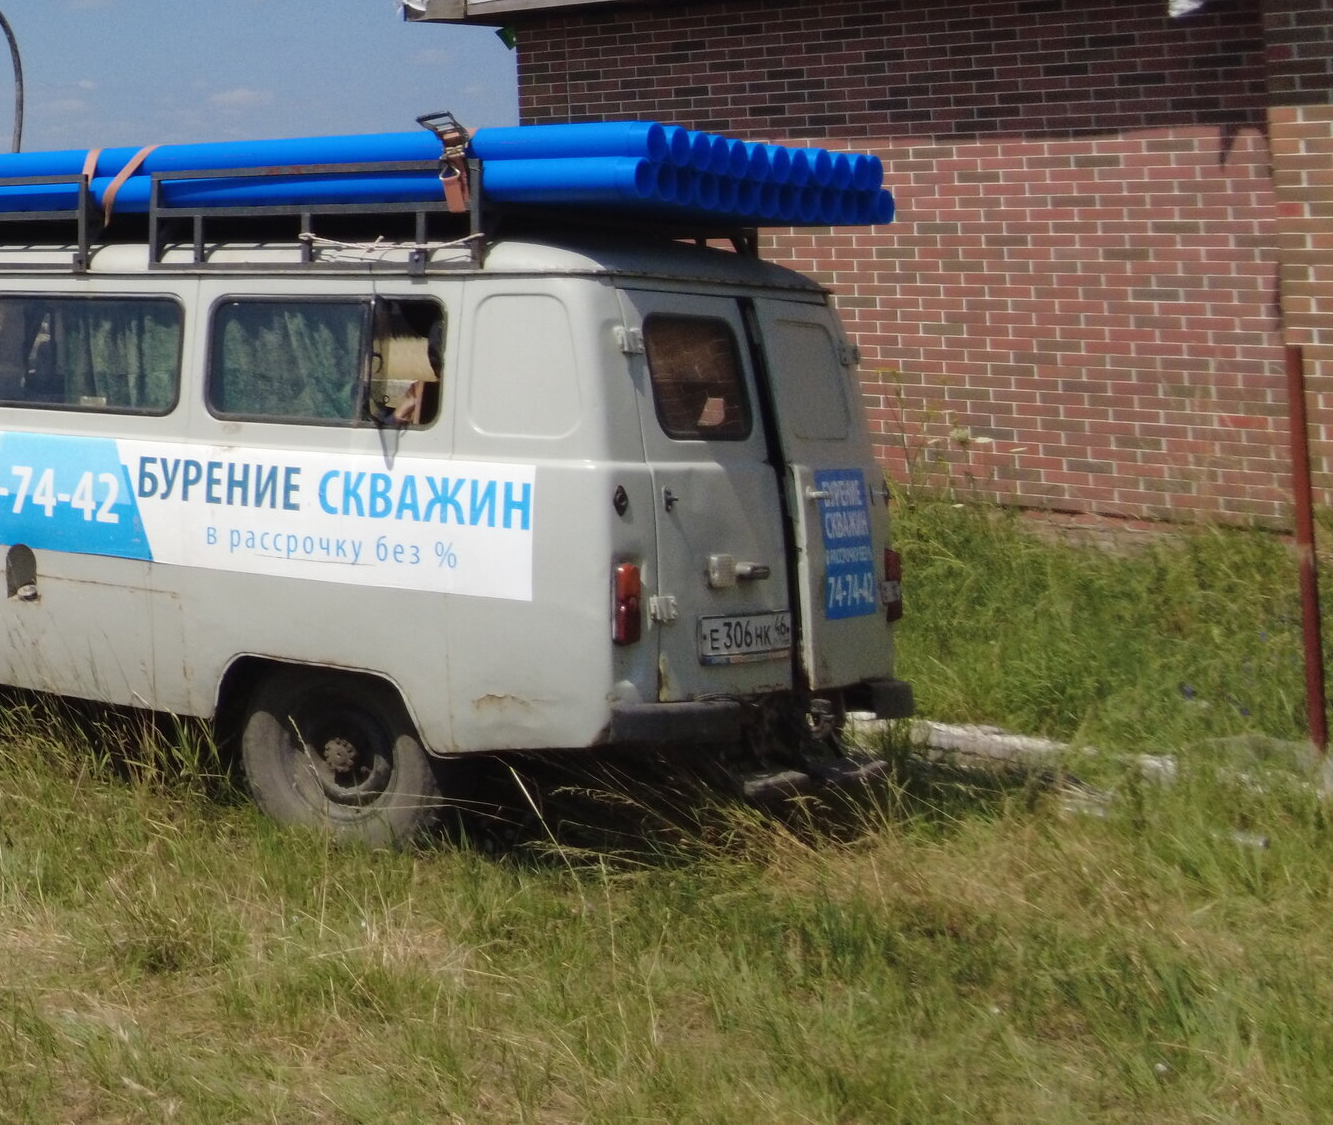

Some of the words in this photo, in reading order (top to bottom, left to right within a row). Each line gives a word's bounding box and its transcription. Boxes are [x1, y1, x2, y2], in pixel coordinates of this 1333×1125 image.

[138, 456, 302, 512] БУРЕНИЕ
[318, 469, 532, 531] СКВАЖИН
[824, 511, 869, 539] СКВАЖИН
[207, 526, 218, 545] в
[229, 528, 362, 565] рассрочку
[376, 535, 420, 565] без
[435, 541, 457, 569] %
[828, 572, 874, 608] 74-74-42
